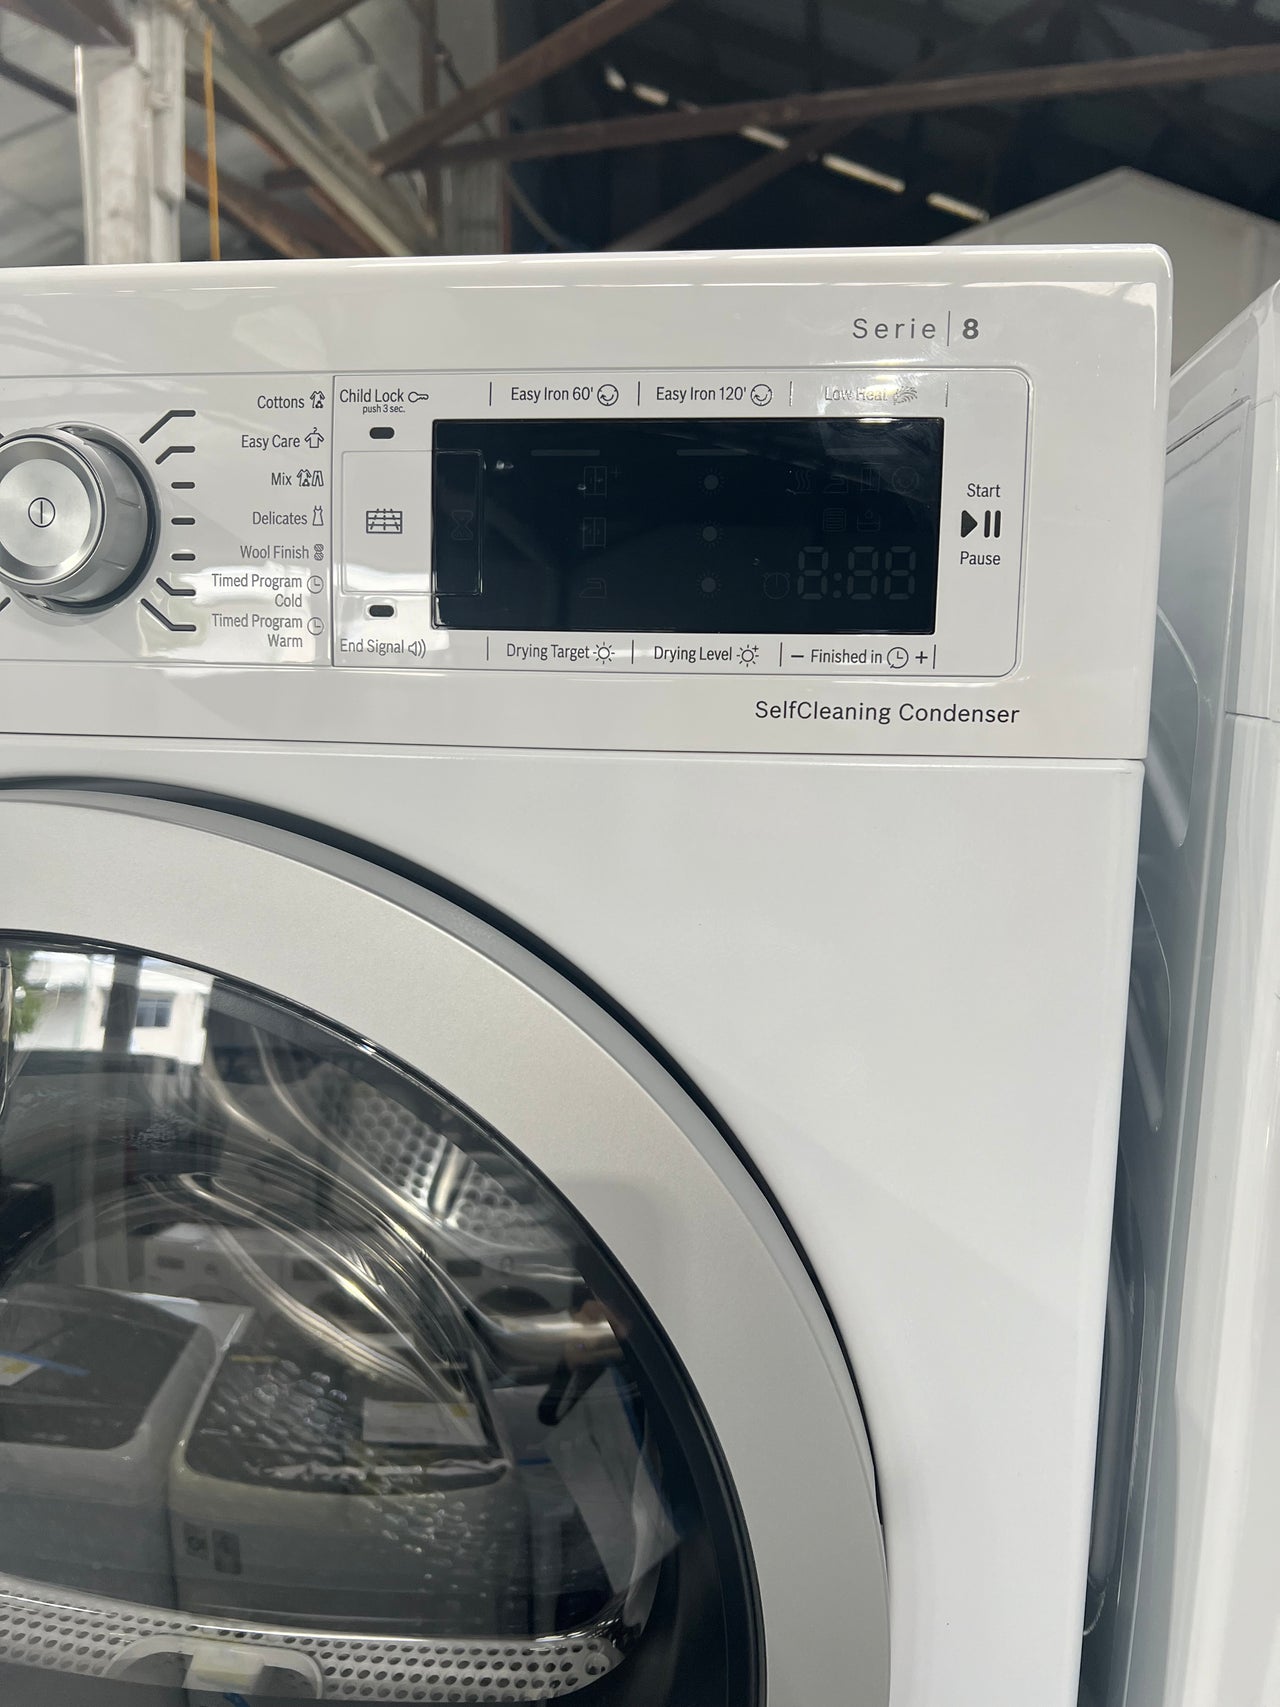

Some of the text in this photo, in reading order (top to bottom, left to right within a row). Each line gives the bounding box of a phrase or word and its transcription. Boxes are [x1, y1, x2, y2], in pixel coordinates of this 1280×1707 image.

[853, 317, 980, 339] Serie 8
[257, 396, 305, 409] Cottons
[340, 389, 404, 403] Child Lock
[511, 387, 541, 403] Easy
[544, 387, 569, 401] Iron
[656, 387, 687, 403] Easy
[690, 387, 715, 401] Iron
[363, 404, 405, 414] push 3 sec.
[241, 435, 300, 449] Easy Care
[271, 473, 292, 485] Mix
[967, 483, 1000, 498] Start
[252, 512, 308, 525] Delicates
[240, 546, 309, 559] Wool Finish
[960, 552, 1000, 566] Pause
[212, 573, 302, 591] Timed Program
[275, 594, 302, 607] Cold
[212, 614, 303, 632] Timed Program
[268, 635, 303, 648] Warm
[340, 639, 404, 655] End Signal
[506, 643, 590, 662] Drying Target
[654, 646, 732, 663] Drying Level
[810, 648, 882, 664] Finished in
[755, 701, 1020, 724] SelfCleaning Condenser
